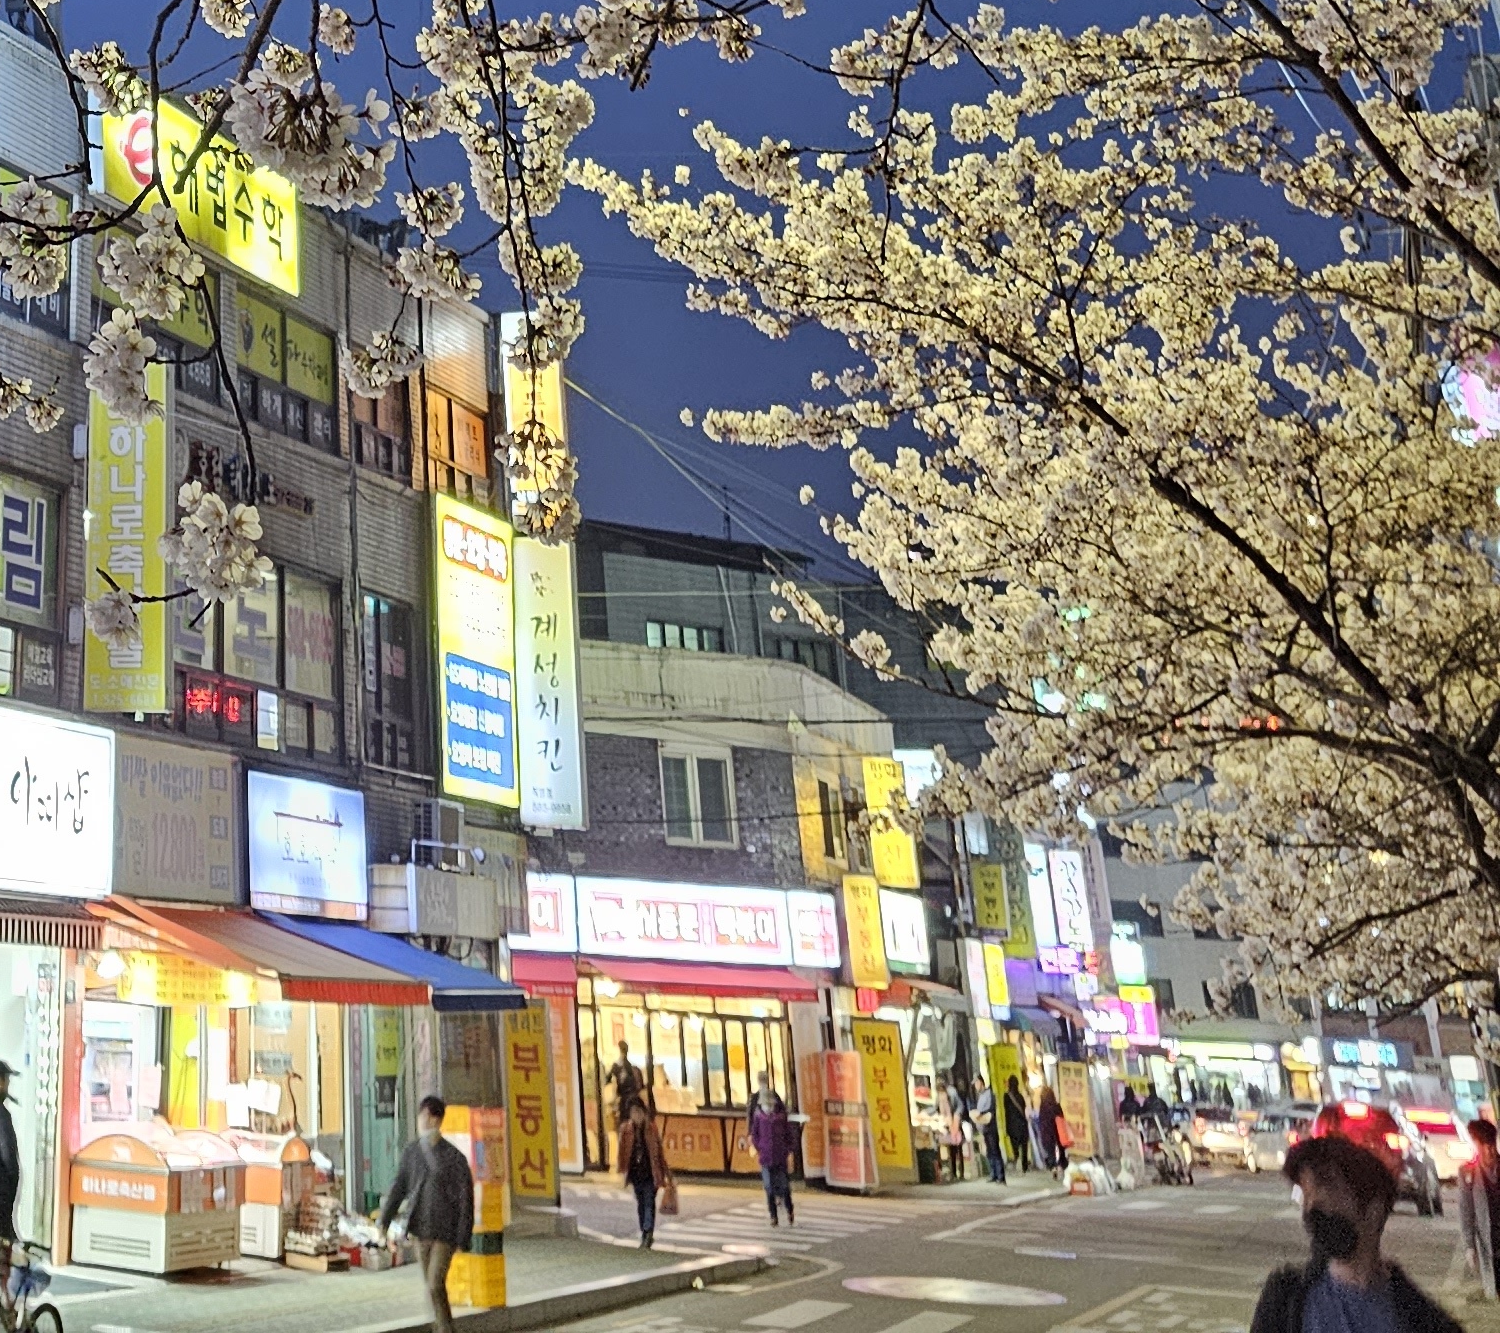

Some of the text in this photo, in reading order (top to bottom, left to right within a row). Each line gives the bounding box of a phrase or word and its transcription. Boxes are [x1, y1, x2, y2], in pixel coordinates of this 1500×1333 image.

[107, 425, 147, 670] 하나로축물
[530, 611, 564, 773] 계성치킨
[512, 1041, 550, 1193] 부동산
[861, 1034, 895, 1058] 평화
[872, 1065, 899, 1156] 부동산
